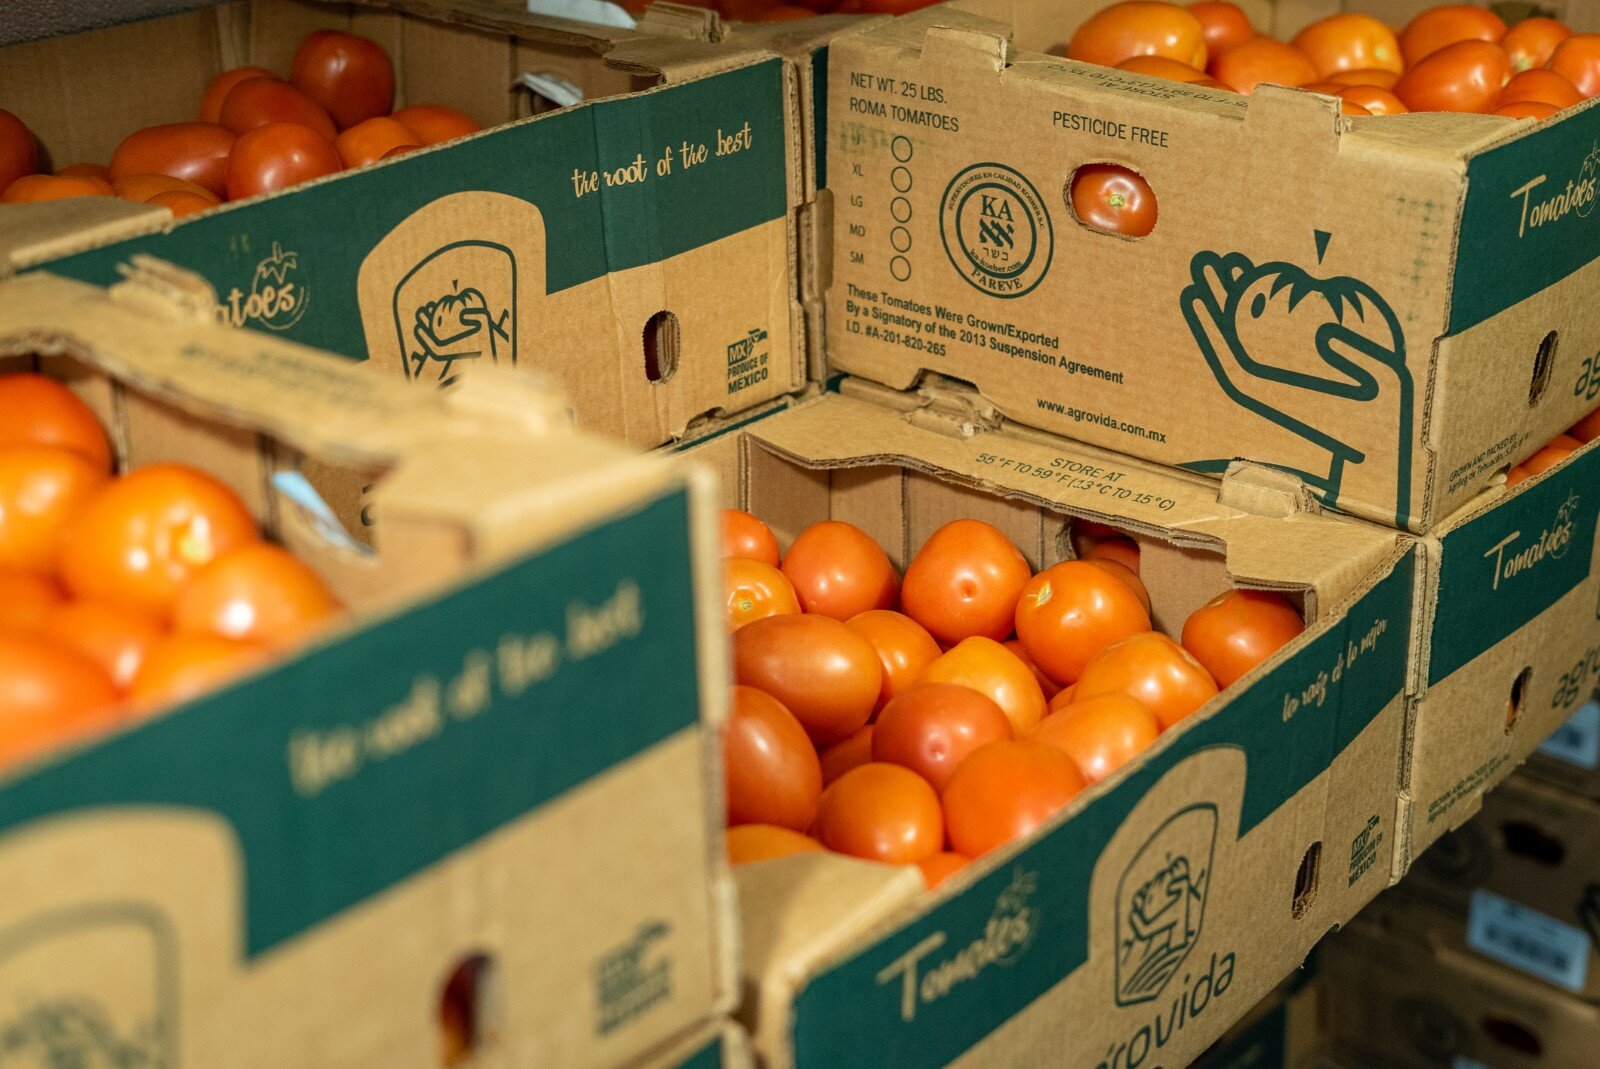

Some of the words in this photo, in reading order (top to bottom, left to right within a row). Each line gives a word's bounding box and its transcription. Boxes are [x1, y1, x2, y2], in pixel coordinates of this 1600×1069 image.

[851, 71, 874, 89] NET
[877, 77, 897, 94] WT.
[901, 81, 917, 98] 25
[921, 85, 947, 104] LBS.
[850, 97, 887, 118] ROMA
[890, 104, 959, 132] TOMATOES
[1053, 111, 1127, 140] PESTICIDE
[1131, 126, 1169, 148] FREE
[571, 168, 599, 198] the
[603, 153, 648, 187] root
[656, 146, 674, 177] of
[679, 141, 708, 169] the
[715, 121, 752, 156] best
[852, 163, 863, 176] XL
[850, 194, 863, 207] LG
[948, 172, 983, 211] SUPERVISORES
[993, 173, 1021, 190] CALIDAD
[1020, 187, 1041, 217] KOSHER
[980, 194, 1014, 222] KA
[1510, 174, 1597, 239] Tomatoes
[849, 223, 866, 237] MD
[849, 251, 864, 264] SM
[969, 248, 1022, 273] ka-kosher.com
[971, 267, 1023, 291] PAREVE
[846, 283, 878, 302] These
[881, 292, 932, 316] Tomatoes
[935, 305, 963, 324] Were
[967, 313, 1059, 349] Grown/Exported
[846, 319, 863, 335] I.D.
[865, 325, 947, 357] #A-201-820-265
[846, 300, 860, 317] By
[862, 307, 869, 316] a
[872, 306, 922, 333] Signatory
[924, 322, 937, 334] of
[939, 324, 957, 339] the
[959, 330, 987, 347] 2013
[990, 337, 1056, 366] Suspension
[1059, 355, 1123, 385] Agreement
[1037, 398, 1167, 444] www.agrovida.com.mx
[1013, 462, 1032, 474] TO
[1111, 487, 1132, 499] TO
[1050, 457, 1103, 478] STORE
[1102, 471, 1127, 482] AT
[1484, 521, 1573, 591] Tomatoes
[875, 905, 1032, 1023] Tomatoes
